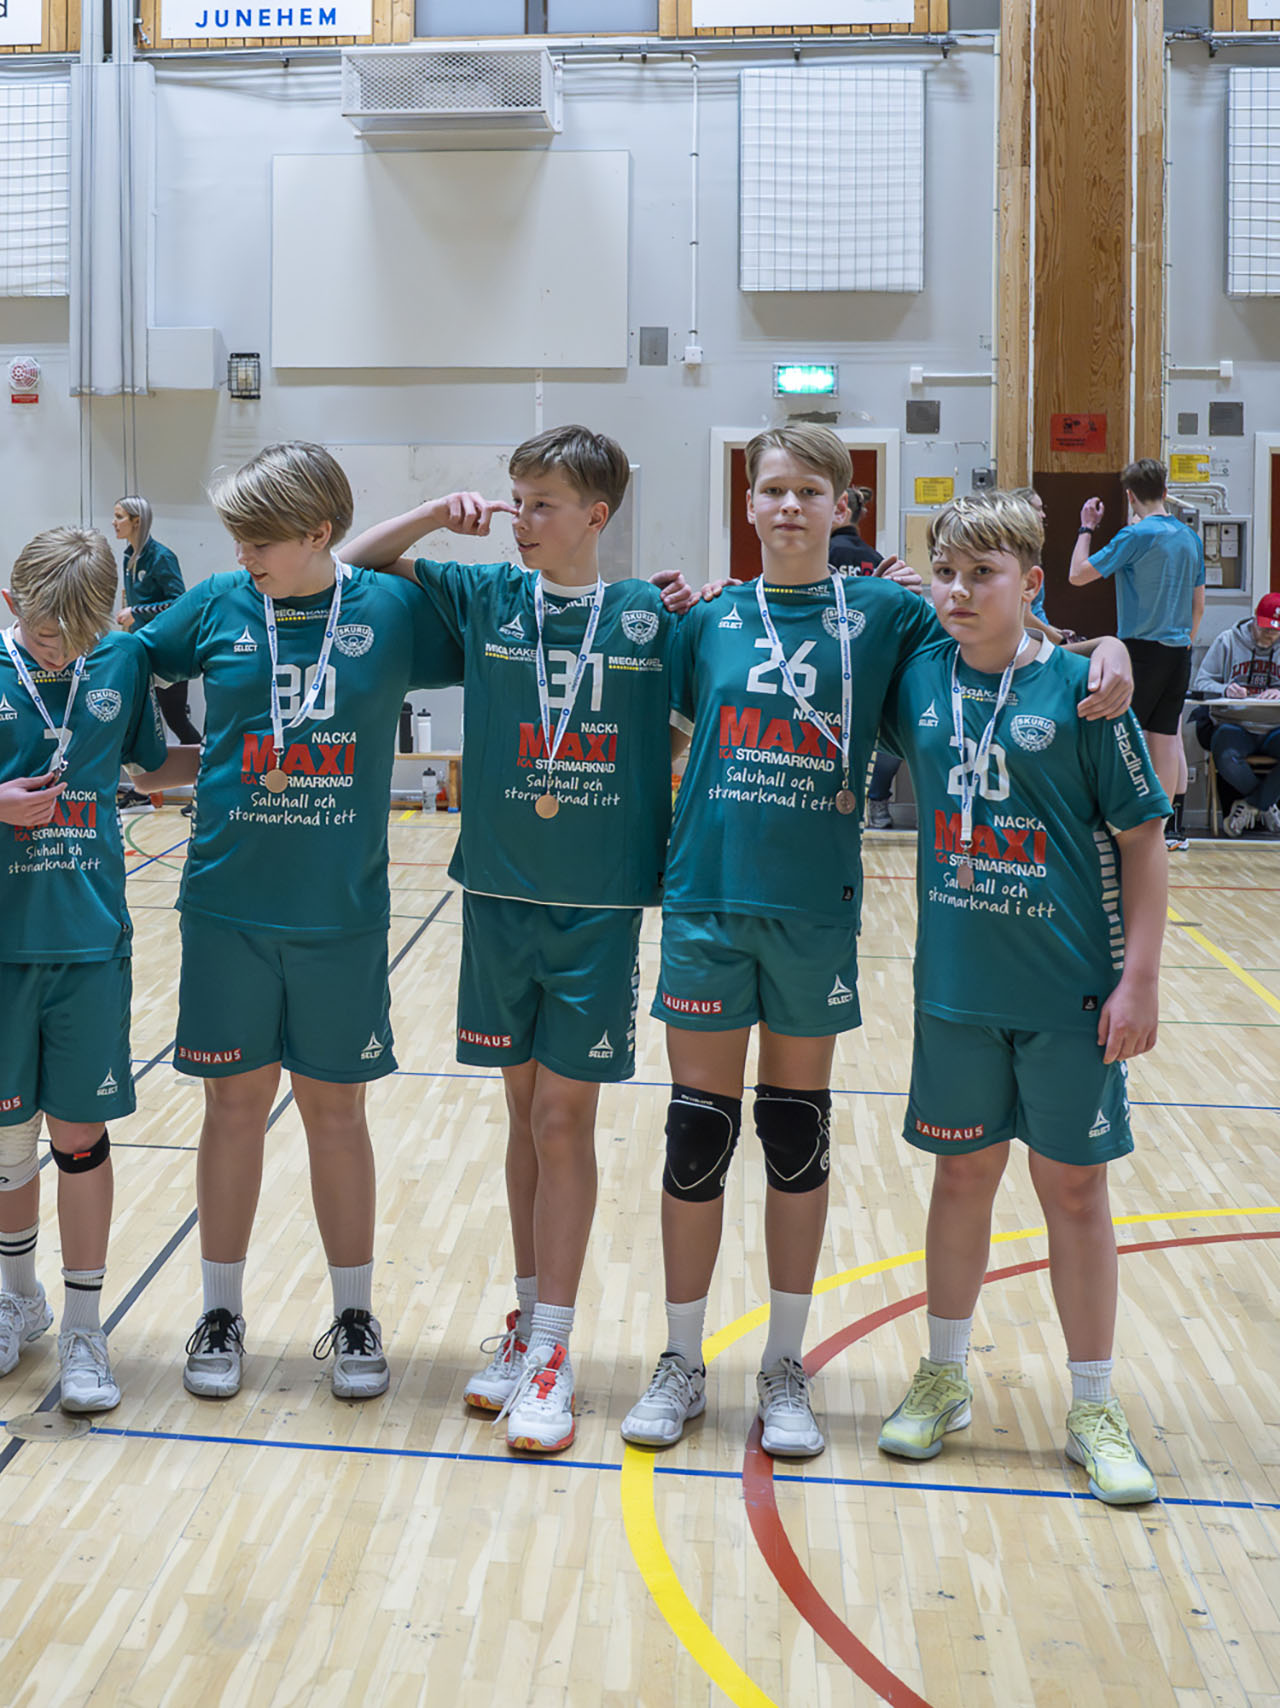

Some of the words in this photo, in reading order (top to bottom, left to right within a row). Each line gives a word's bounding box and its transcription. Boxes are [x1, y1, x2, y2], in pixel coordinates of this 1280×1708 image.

[195, 7, 336, 28] JUNEHEM
[337, 626, 368, 636] SKURU
[718, 621, 743, 629] SELECT
[233, 644, 258, 652] SELECT
[746, 638, 817, 698] 26
[548, 650, 604, 712] 31
[581, 722, 618, 734] NACKA
[1017, 716, 1050, 729] SKURU
[311, 732, 357, 744] NACKA
[720, 705, 840, 759] MAXI
[518, 722, 617, 762] MAXI
[241, 733, 356, 775] MAXI
[736, 748, 835, 772] STORMARKNAD
[1113, 722, 1149, 797] stadium
[947, 735, 1010, 801] 20
[259, 776, 353, 788] SRMARKNAD
[583, 779, 603, 791] och
[726, 766, 786, 788] Saluhall
[790, 776, 815, 792] och
[61, 790, 97, 801] NACKA
[250, 792, 308, 808] Saluhall
[314, 794, 336, 809] och
[593, 794, 597, 806] i
[601, 793, 621, 806] ett
[801, 793, 806, 808] i
[811, 796, 835, 811] ett
[229, 806, 320, 826] stormarknad
[325, 810, 330, 825] i
[334, 809, 357, 825] ett
[994, 815, 1047, 831] NACKA
[934, 809, 1047, 864] MAXI
[80, 858, 101, 871] ett
[1002, 882, 1028, 899] och
[928, 886, 1009, 915] stormarknad
[1016, 901, 1021, 915] i
[1027, 902, 1056, 919] ett
[663, 993, 721, 1012] AUHAUS
[827, 993, 852, 1006] SELECT
[458, 1029, 511, 1046] AUHAUS
[588, 1050, 613, 1059] SELECT
[96, 1085, 118, 1096] SELECT
